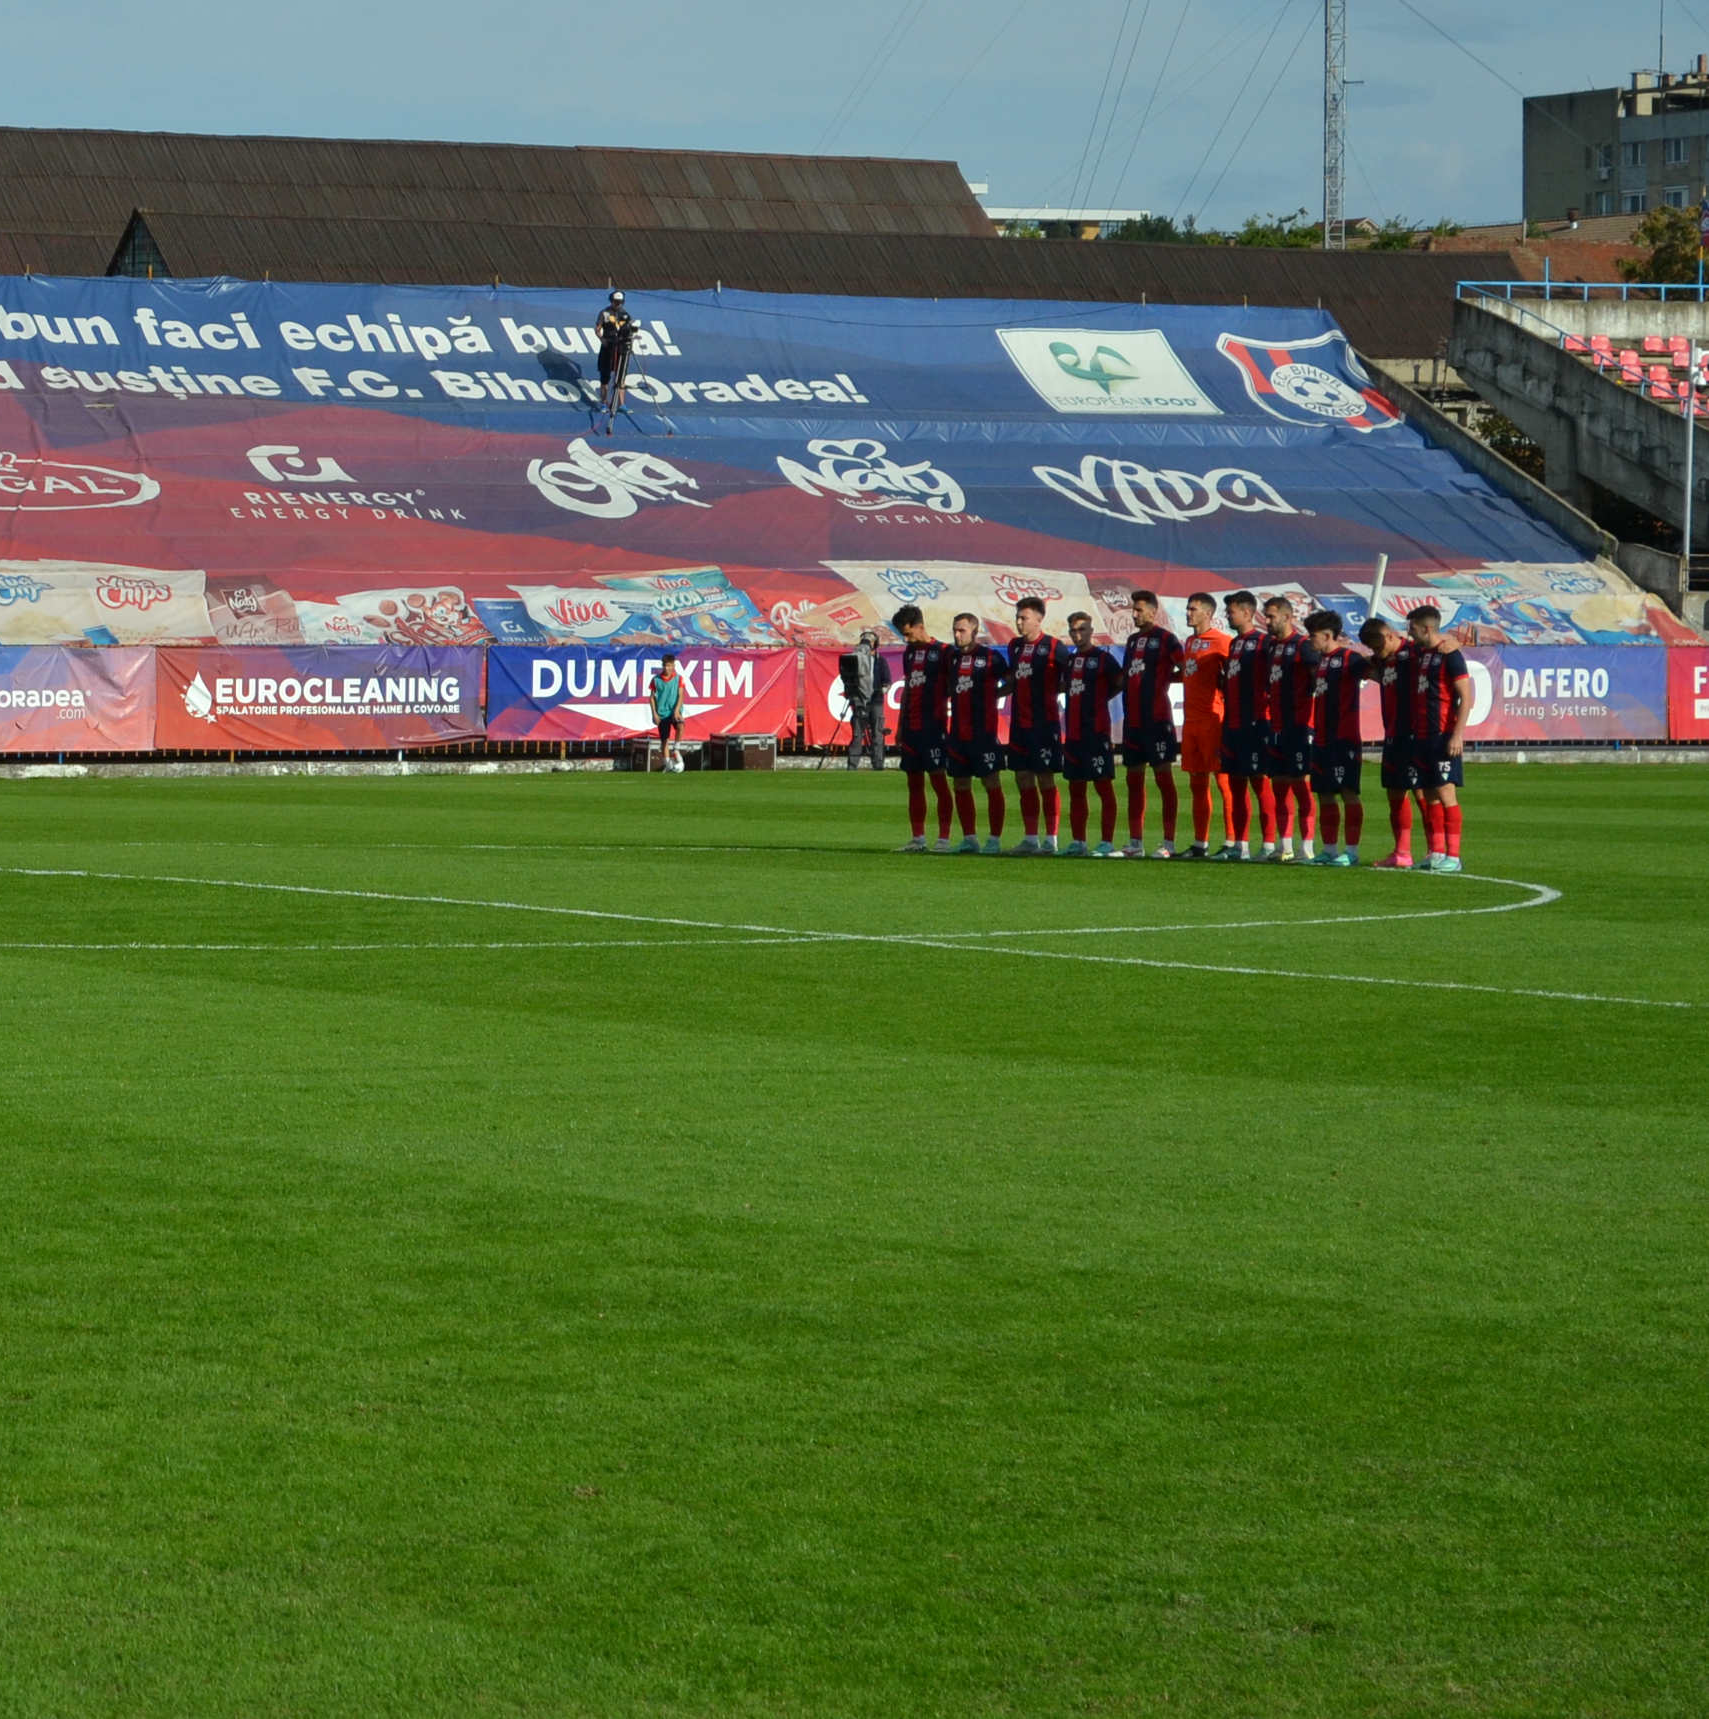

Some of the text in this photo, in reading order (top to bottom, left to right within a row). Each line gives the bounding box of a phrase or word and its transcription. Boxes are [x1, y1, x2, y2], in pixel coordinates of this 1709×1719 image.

[134, 308, 260, 349] faci
[280, 314, 492, 361] echipă
[500, 318, 681, 355] bu!
[1274, 366, 1342, 388] F.C. BIHOR
[292, 367, 423, 397] F.C.
[624, 374, 868, 403] Oradea!
[1305, 402, 1364, 416] ORADEA
[777, 445, 965, 513] Naty
[244, 492, 415, 505] RIENERGY
[231, 508, 466, 519] ENERGY DRINK
[856, 514, 983, 523] PREMIUM
[878, 568, 929, 584] Viva
[991, 574, 1043, 589] Viva
[651, 577, 693, 590] Viva
[888, 577, 948, 601] Chips
[97, 582, 171, 609] Chips
[653, 592, 702, 611] COCOA
[229, 595, 257, 612] Naty
[546, 599, 611, 628] Viva
[325, 621, 360, 635] Naty
[215, 677, 460, 703] EUROCLEANING
[1503, 668, 1608, 698] DAFERO
[57, 708, 85, 719] .com
[216, 704, 460, 715] SPALATORIE PROFESIONALA DE HAINE & COVOARE
[1504, 702, 1607, 719] Fixing Systems
[931, 748, 940, 758] 10
[1156, 742, 1166, 752] 16
[984, 752, 995, 762] 30
[1092, 756, 1104, 766] 28
[1252, 753, 1258, 762] 6
[1296, 752, 1303, 762] 9
[1438, 762, 1451, 771] 75
